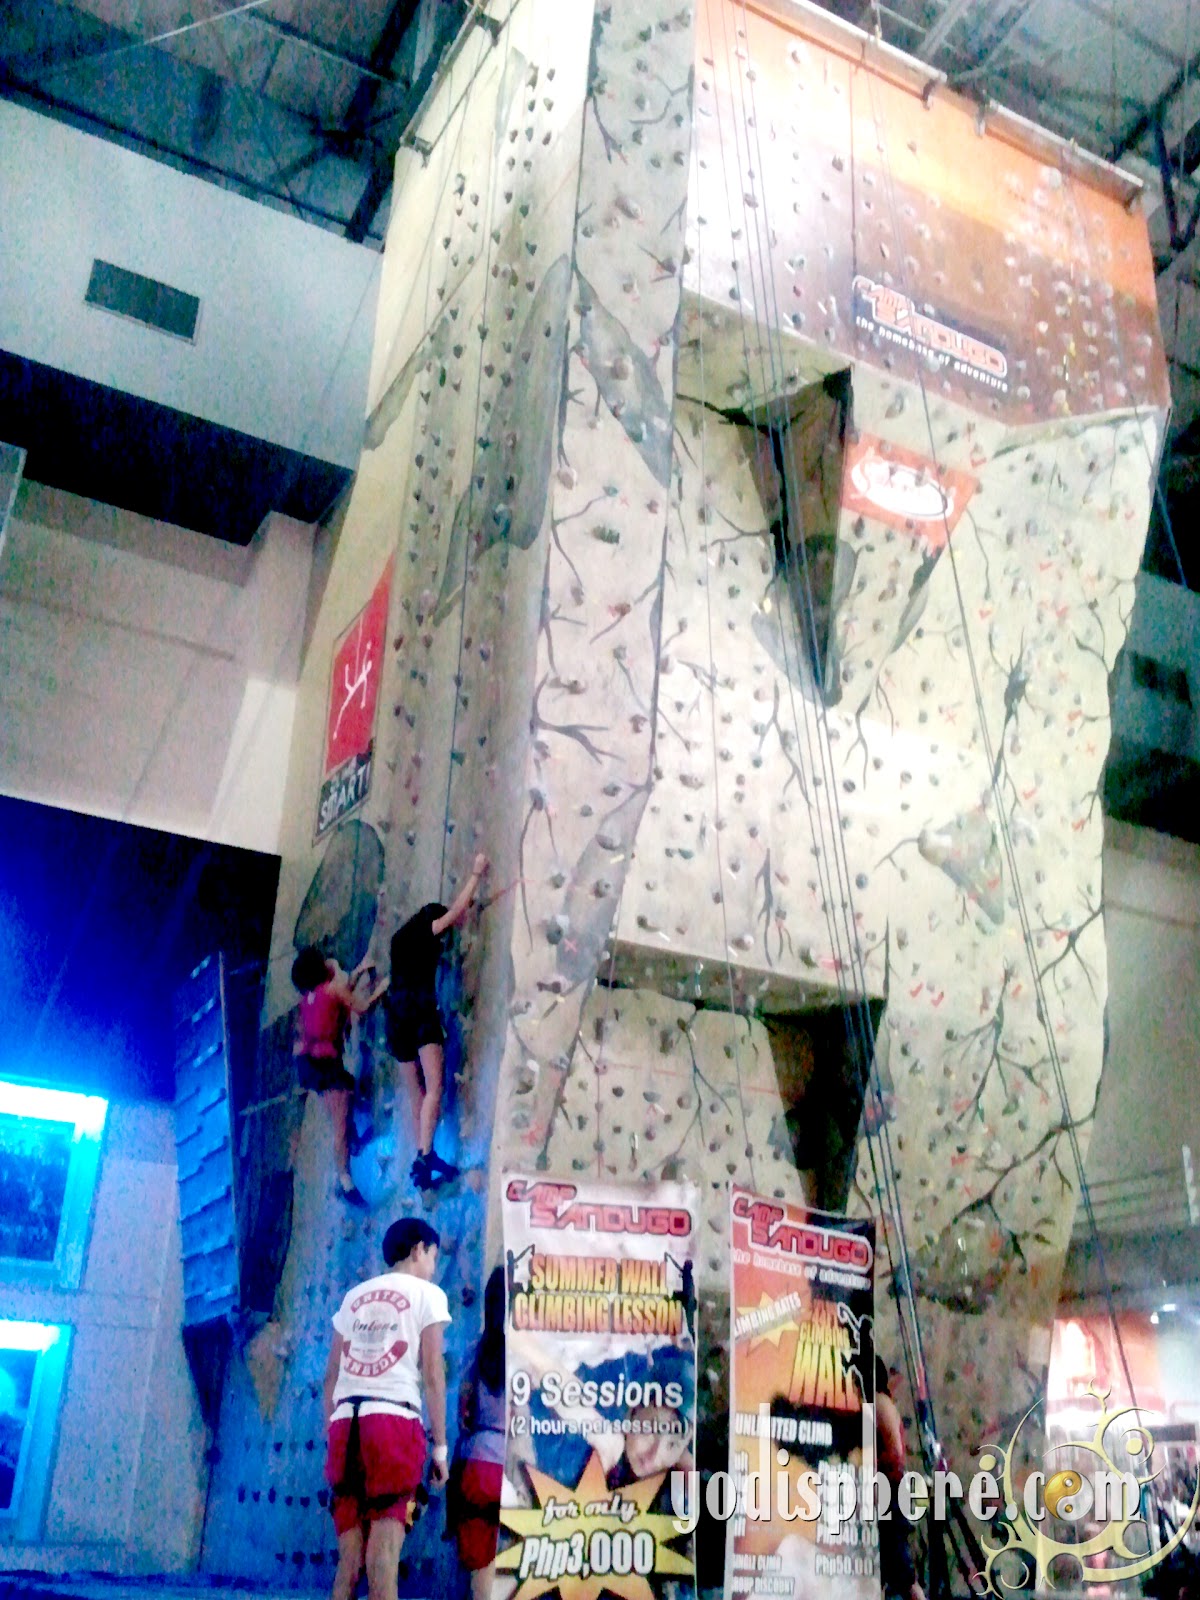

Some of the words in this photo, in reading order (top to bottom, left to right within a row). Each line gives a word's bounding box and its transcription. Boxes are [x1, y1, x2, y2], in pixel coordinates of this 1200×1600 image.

[855, 316, 875, 332] the
[938, 354, 950, 366] of
[953, 361, 1008, 393] adventure
[506, 1179, 578, 1204] CAMP
[733, 1196, 785, 1221] CAMP
[530, 1202, 692, 1237] SANDUGO
[751, 1221, 869, 1268] SANDUGO
[531, 1253, 618, 1292] SUMMER
[620, 1258, 667, 1295] WALL
[351, 1290, 410, 1312] UNITED
[513, 1292, 610, 1332] CLIMBING
[611, 1295, 683, 1335] LESSON
[511, 1371, 531, 1406] 9
[541, 1372, 684, 1409] Sessions
[510, 1416, 526, 1438] (2
[530, 1416, 578, 1436] hours
[582, 1418, 608, 1438] per
[611, 1417, 690, 1437] session)
[735, 1412, 797, 1443] UNLIITED
[543, 1496, 580, 1527] for
[583, 1493, 641, 1524] only
[518, 1529, 656, 1580] Php3,000
